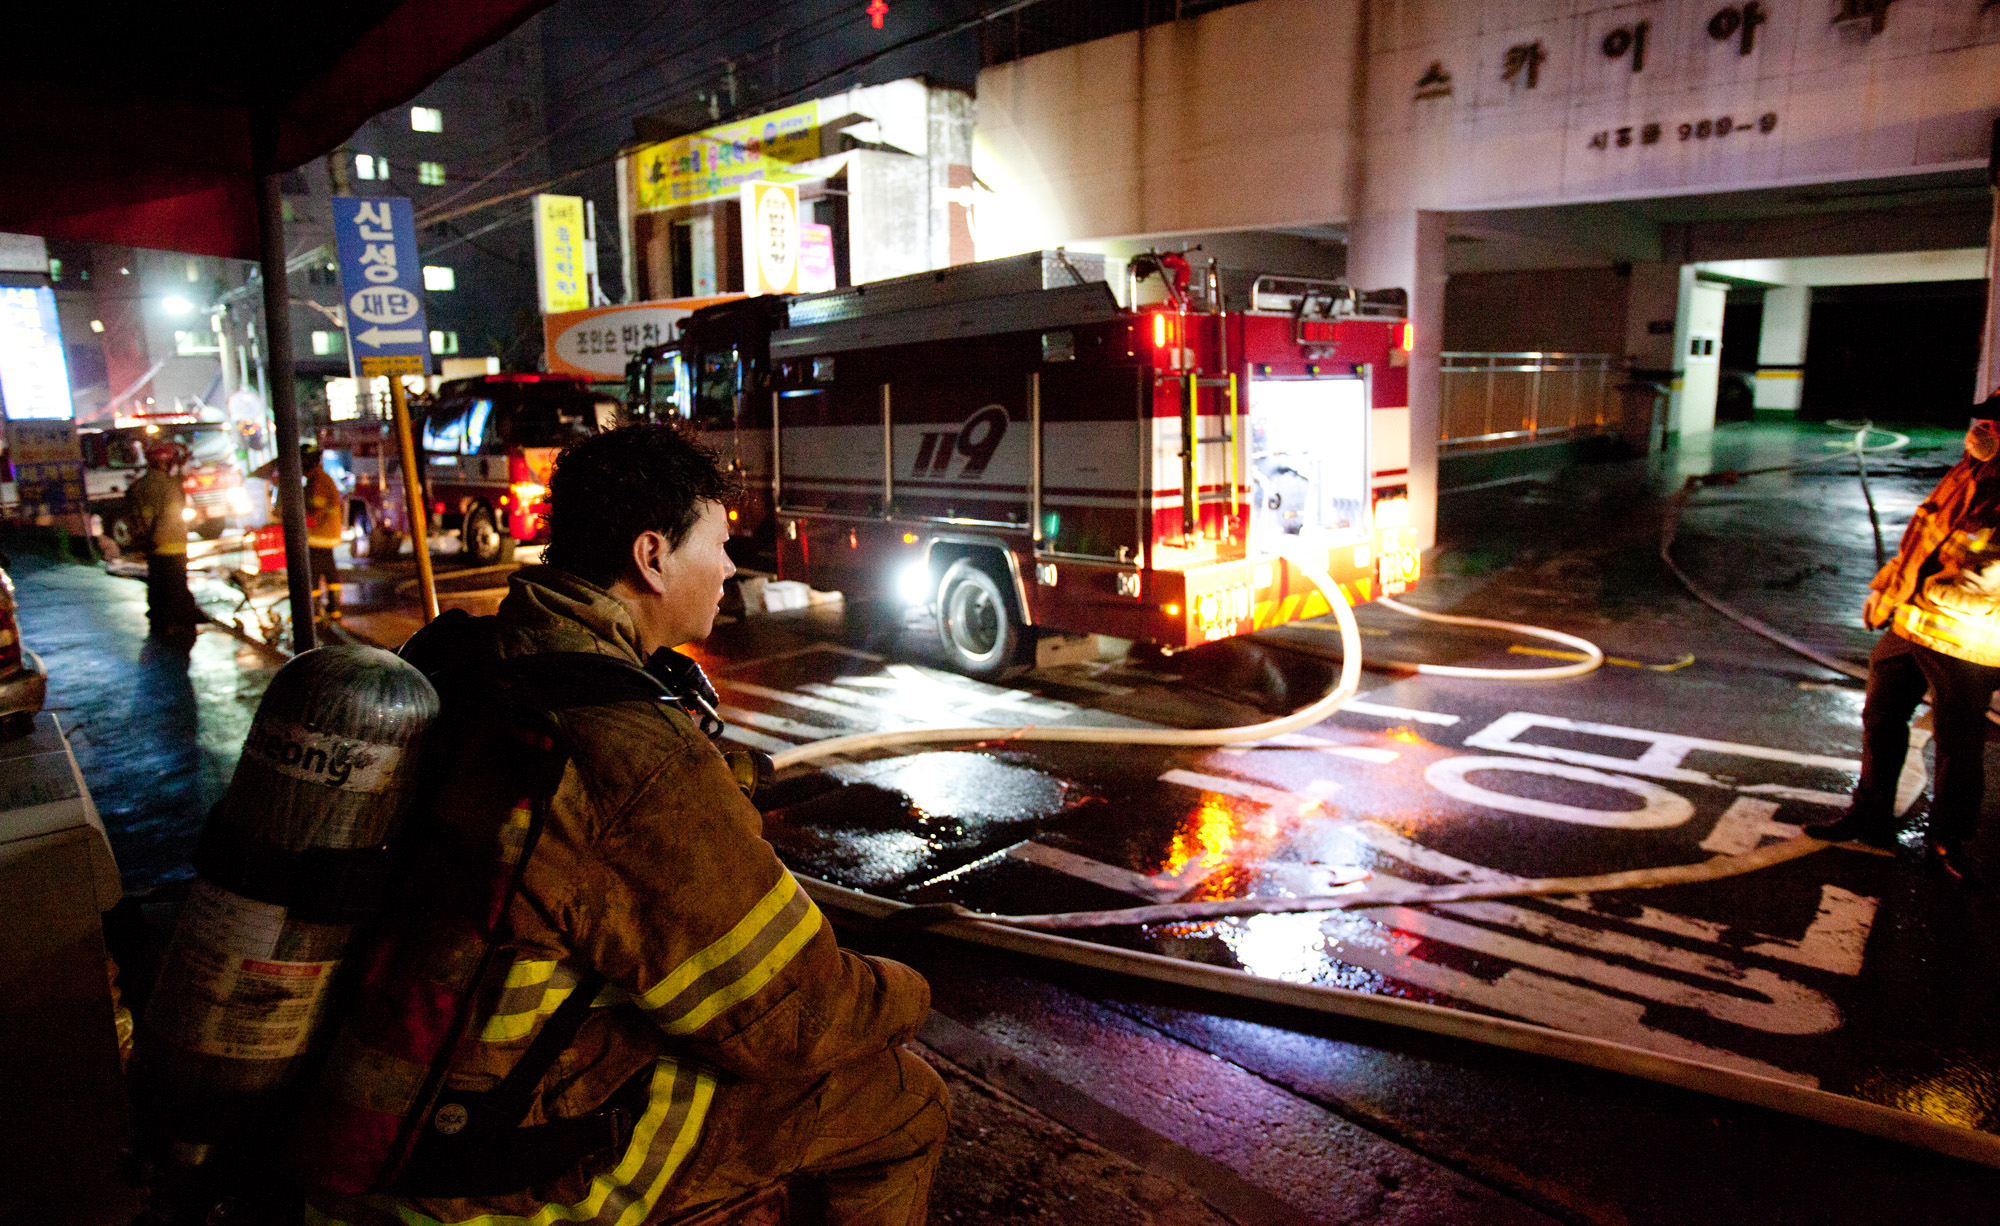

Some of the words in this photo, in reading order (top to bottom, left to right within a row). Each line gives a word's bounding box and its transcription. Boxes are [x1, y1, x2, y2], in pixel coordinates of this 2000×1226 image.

[353, 201, 399, 284] 신성
[361, 294, 409, 316] 재단
[911, 404, 1010, 479] 119
